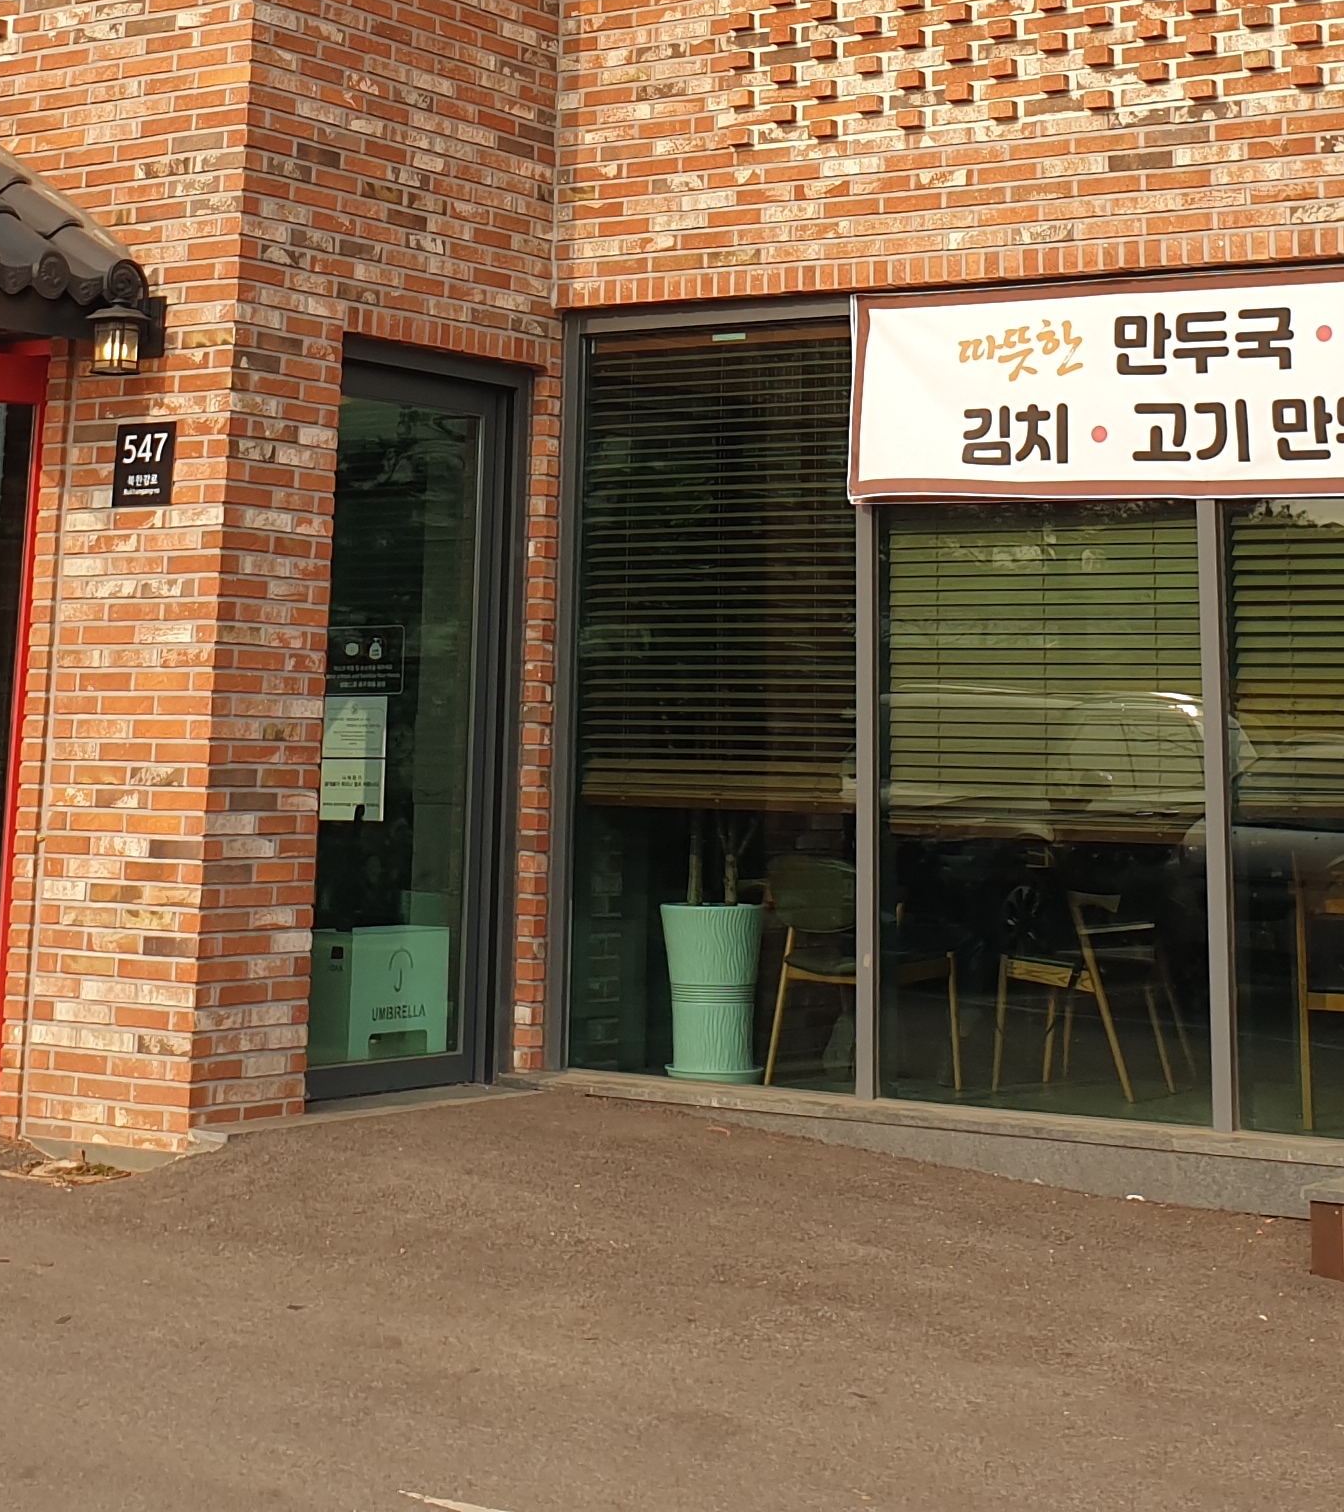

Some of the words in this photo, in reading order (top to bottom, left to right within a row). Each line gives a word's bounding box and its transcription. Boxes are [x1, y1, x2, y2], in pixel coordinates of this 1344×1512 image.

[957, 319, 1084, 382] 따뜻한
[1114, 306, 1294, 376] 만두국
[122, 432, 169, 464] 547
[961, 402, 1069, 465] 김치
[1131, 398, 1251, 463] 고기
[371, 1003, 428, 1022] UMBRELLA
